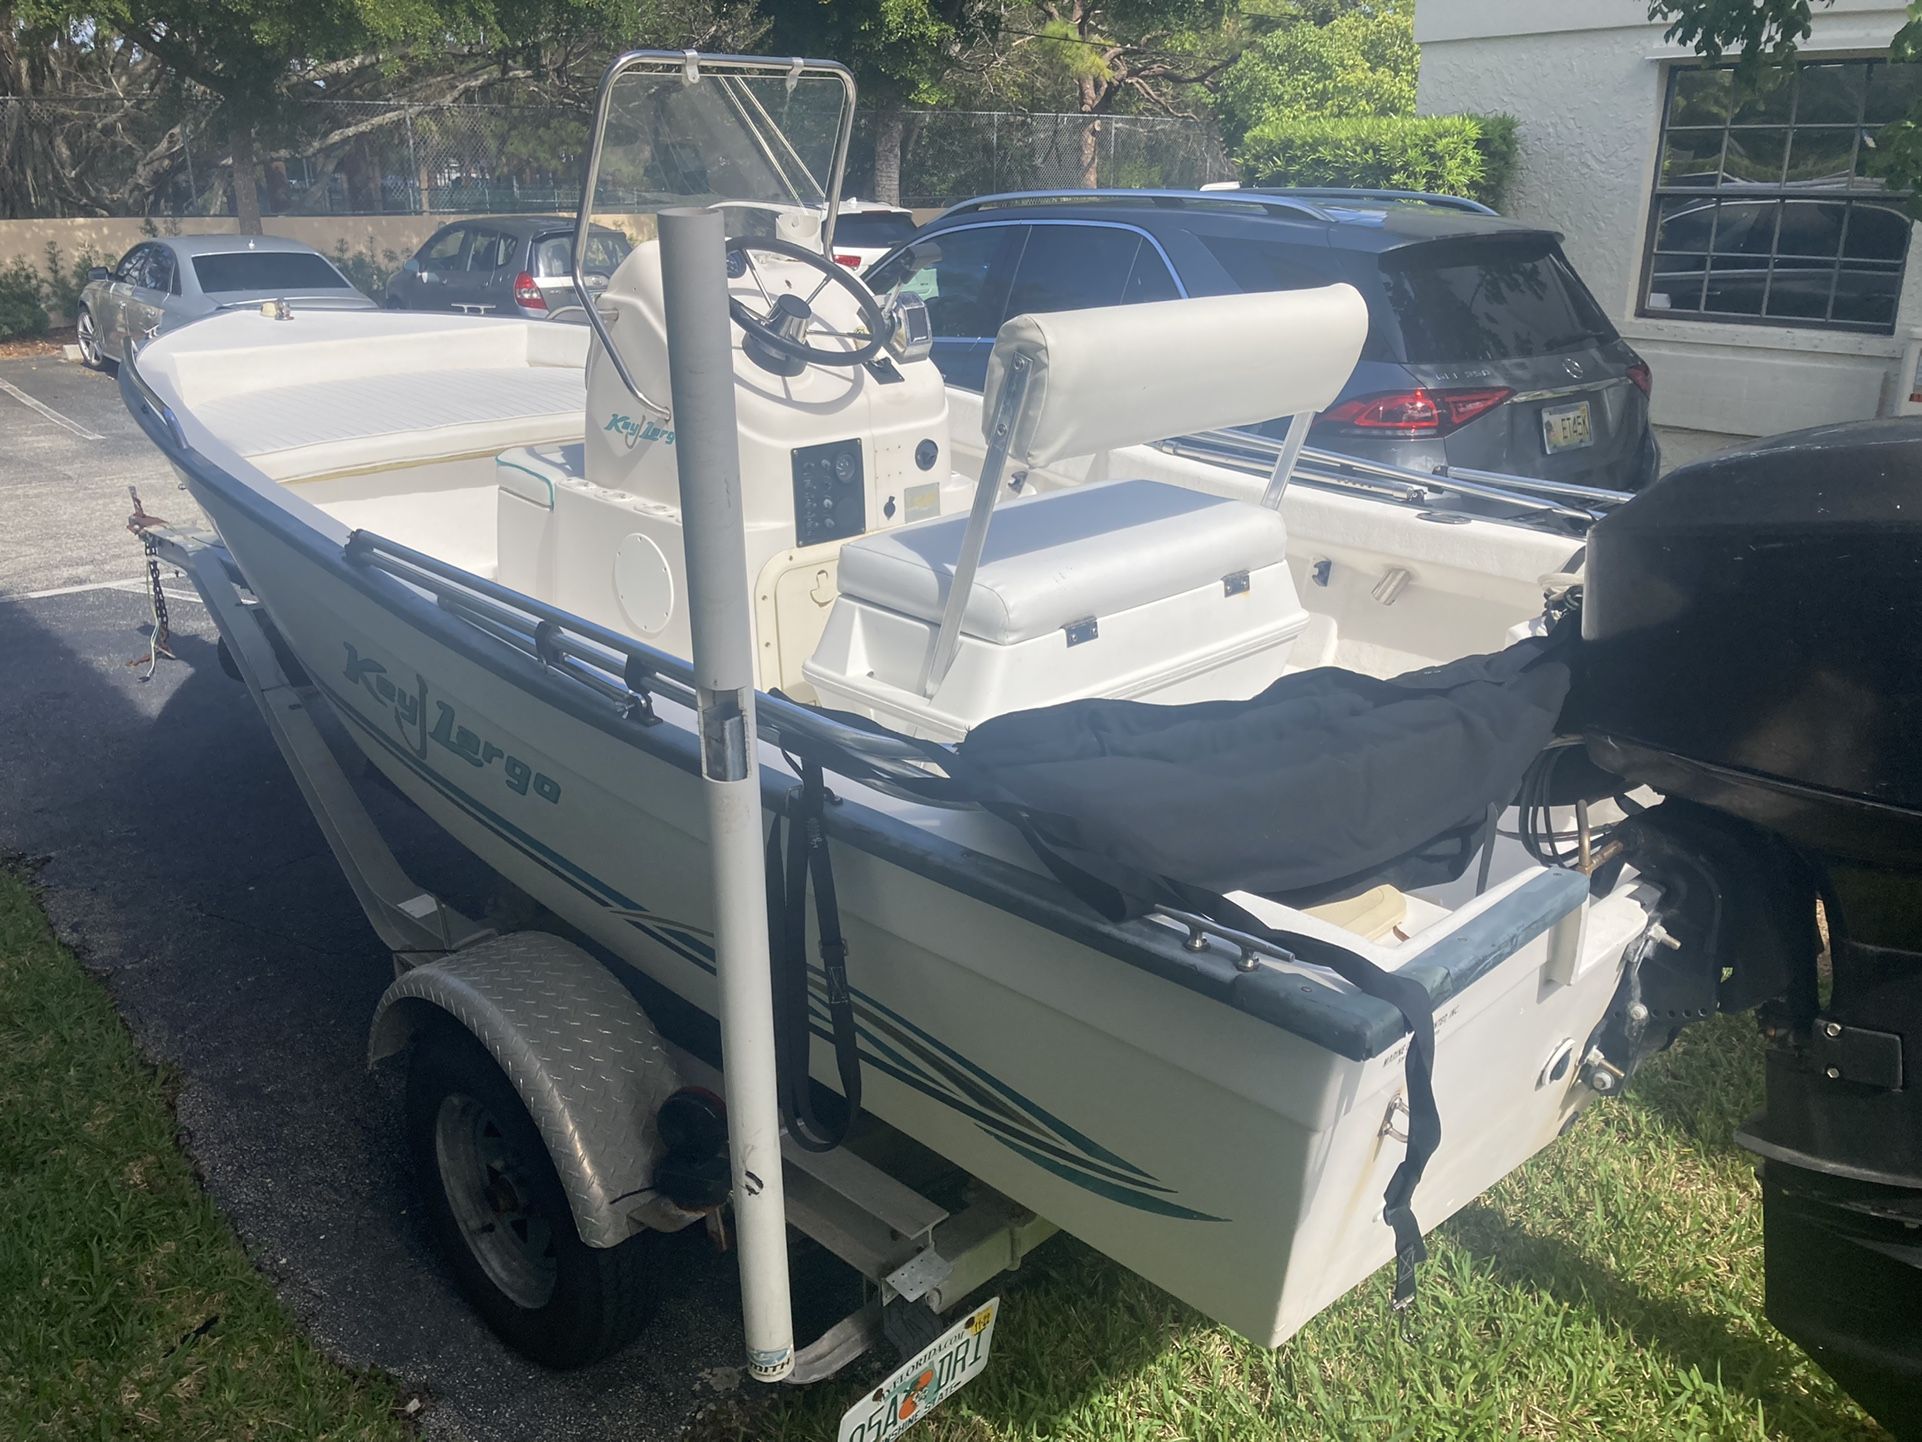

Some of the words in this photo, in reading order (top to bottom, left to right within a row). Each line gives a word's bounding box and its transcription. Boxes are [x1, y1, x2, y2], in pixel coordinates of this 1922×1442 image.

[343, 641, 427, 759] Key
[428, 701, 562, 804] Largo
[935, 1327, 986, 1394] DRI
